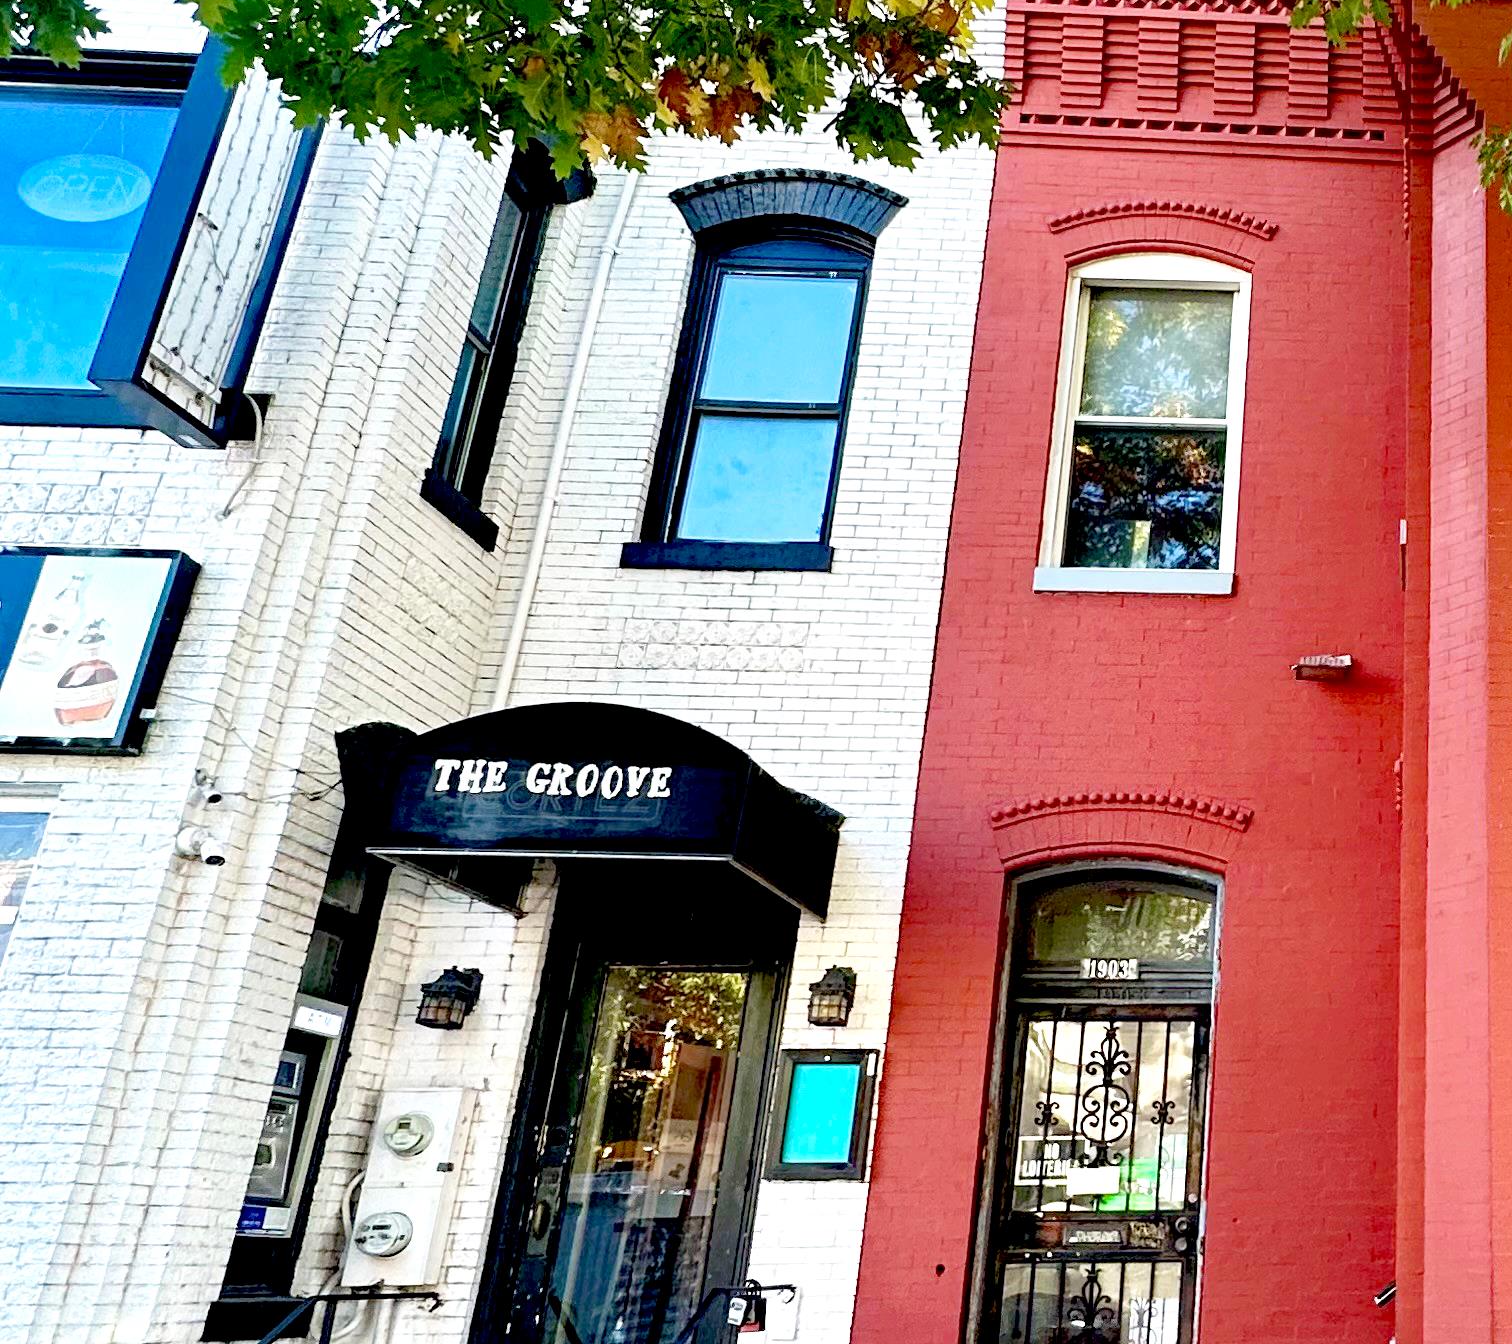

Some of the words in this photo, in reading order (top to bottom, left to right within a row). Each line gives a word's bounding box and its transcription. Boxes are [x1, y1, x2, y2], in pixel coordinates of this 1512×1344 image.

[31, 174, 145, 207] OPEN
[434, 758, 508, 794] THE
[526, 761, 672, 800] GROOVE
[1088, 959, 1129, 979] 1903
[1043, 1142, 1061, 1160] NO
[1022, 1158, 1080, 1178] LOITERI
